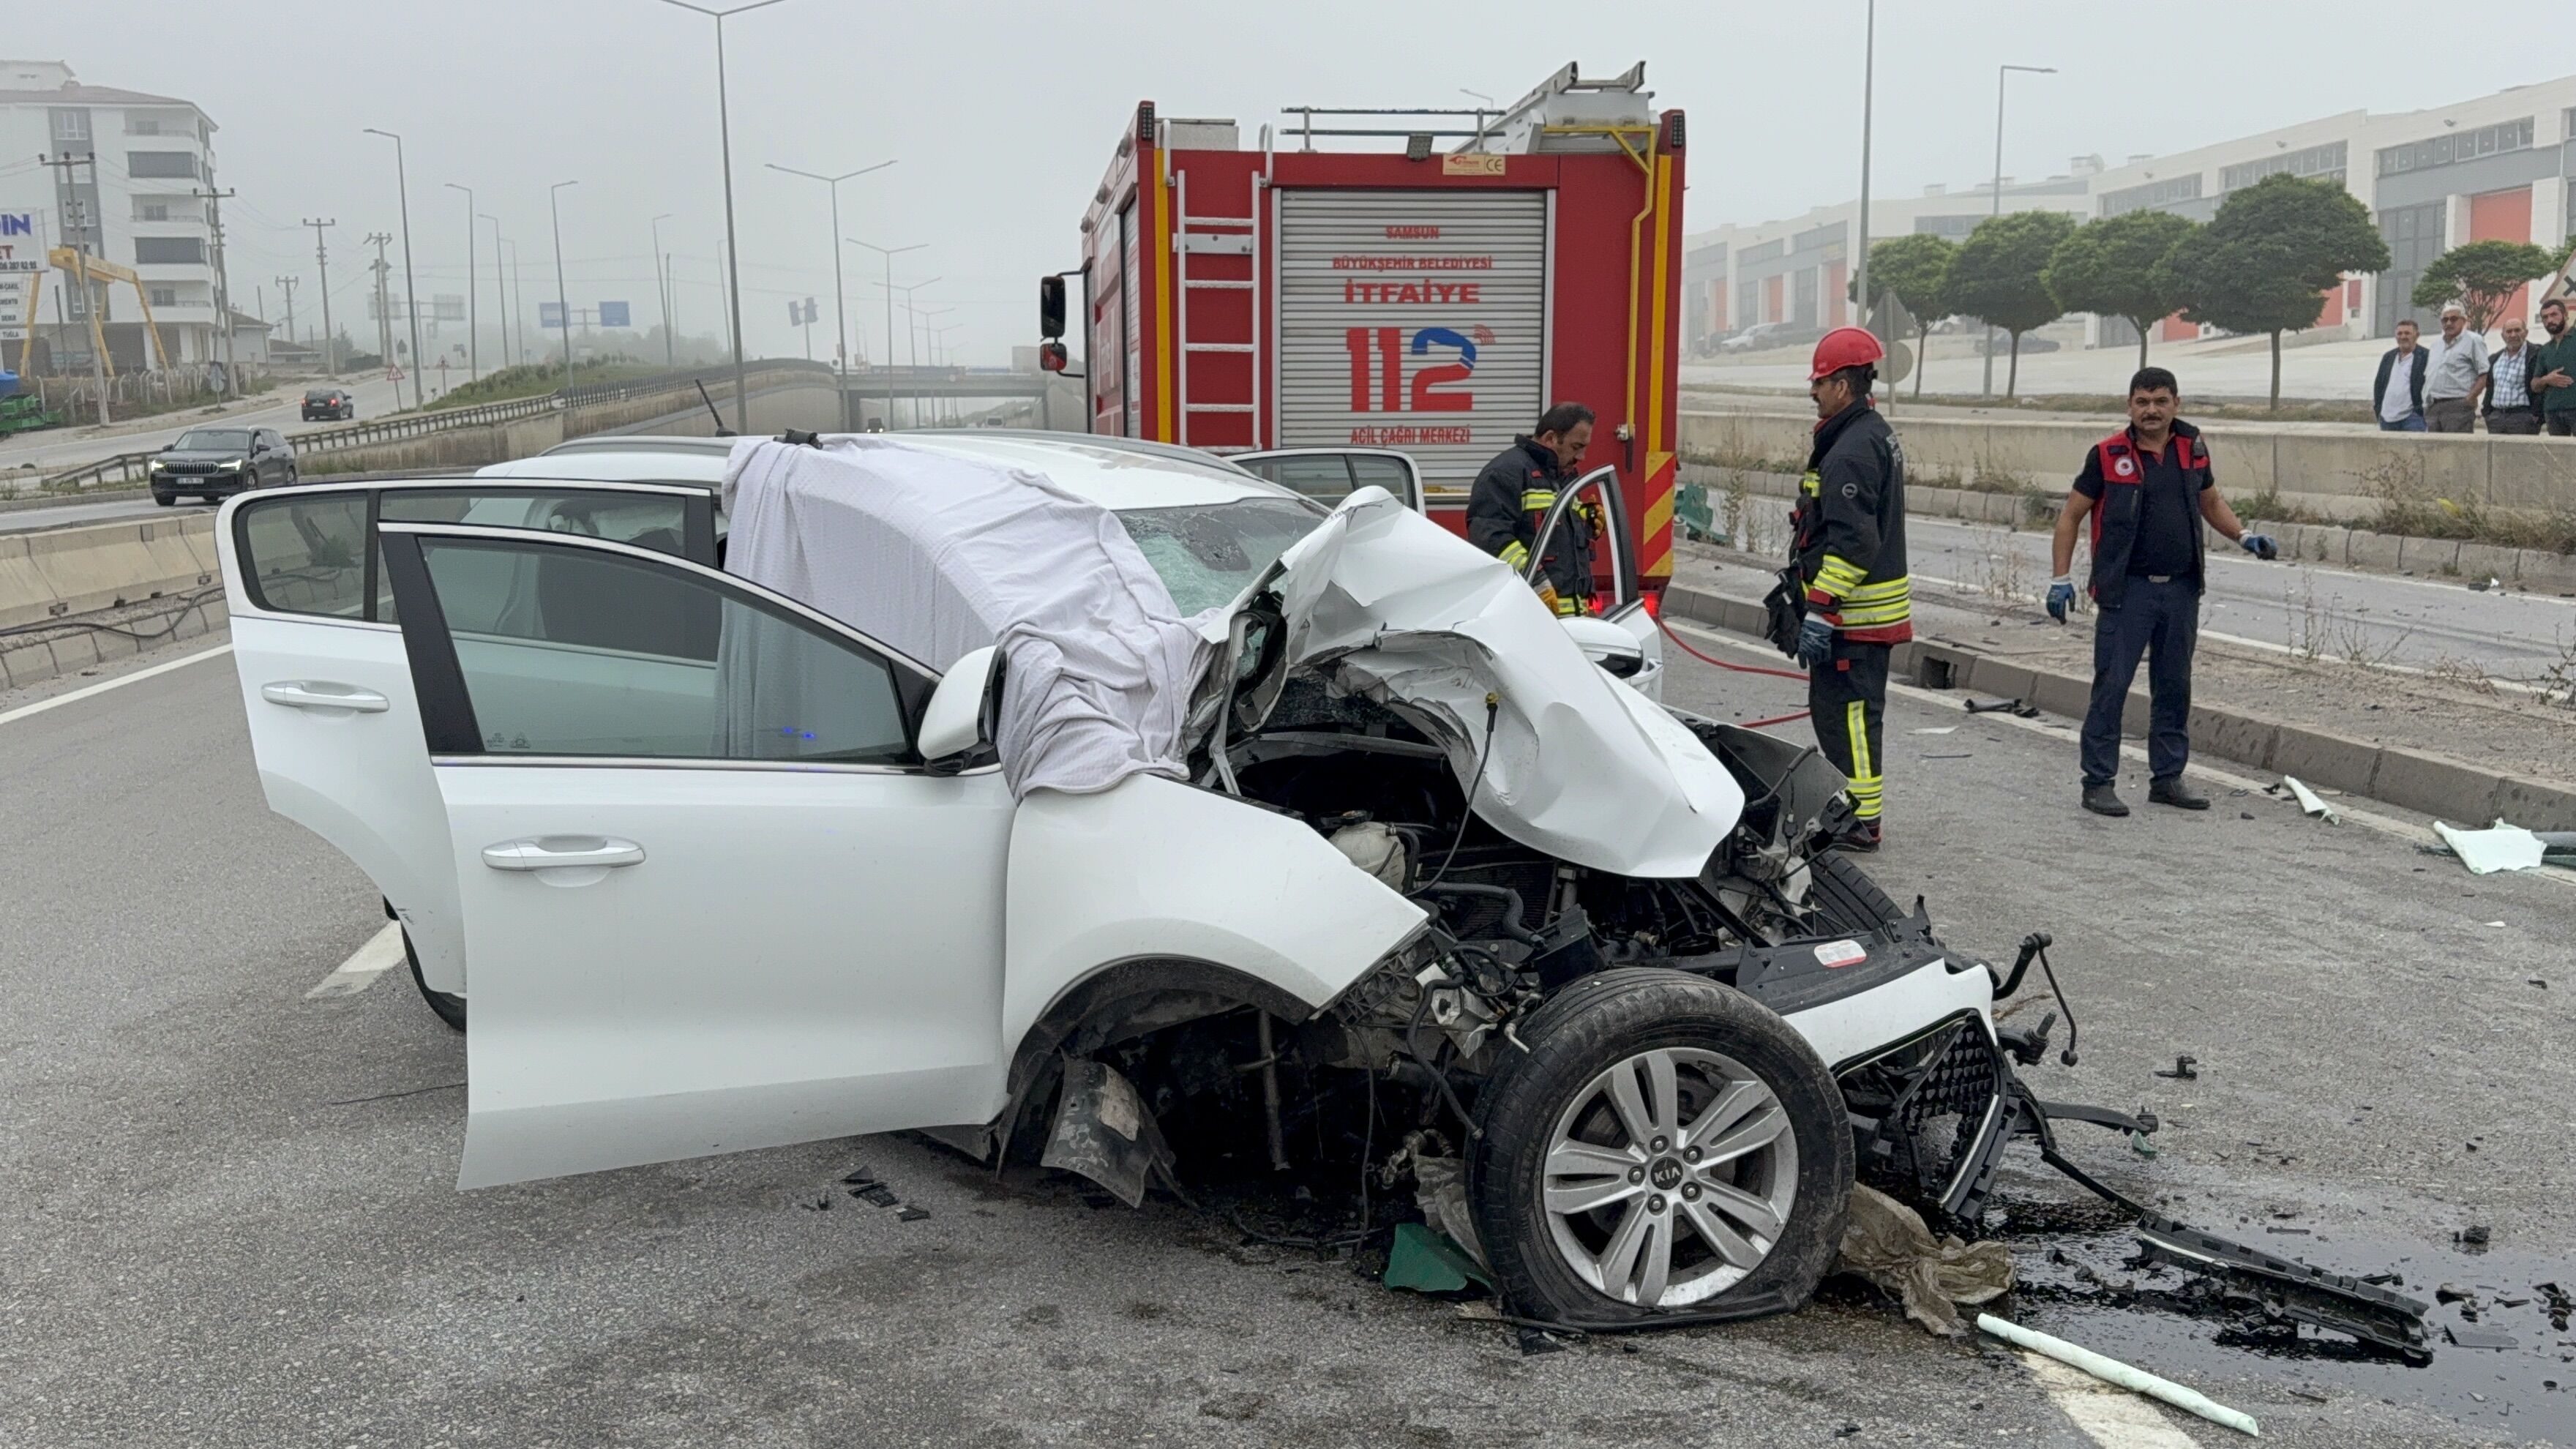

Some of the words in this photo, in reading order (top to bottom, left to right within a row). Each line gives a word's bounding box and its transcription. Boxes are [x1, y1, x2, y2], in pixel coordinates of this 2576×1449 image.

[1486, 158, 1502, 172] CE
[0, 213, 31, 236] IN
[1385, 225, 1439, 239] SAMSUN
[1419, 255, 1492, 270] BELEDİYESİ
[1344, 278, 1480, 304] İTFAİYE
[1346, 326, 1477, 412] 112
[1350, 425, 1377, 445] ACİL
[1380, 424, 1415, 449] ÇAĞRI
[1420, 424, 1470, 444] MERKEZİ
[1654, 1167, 1681, 1183] KIA
